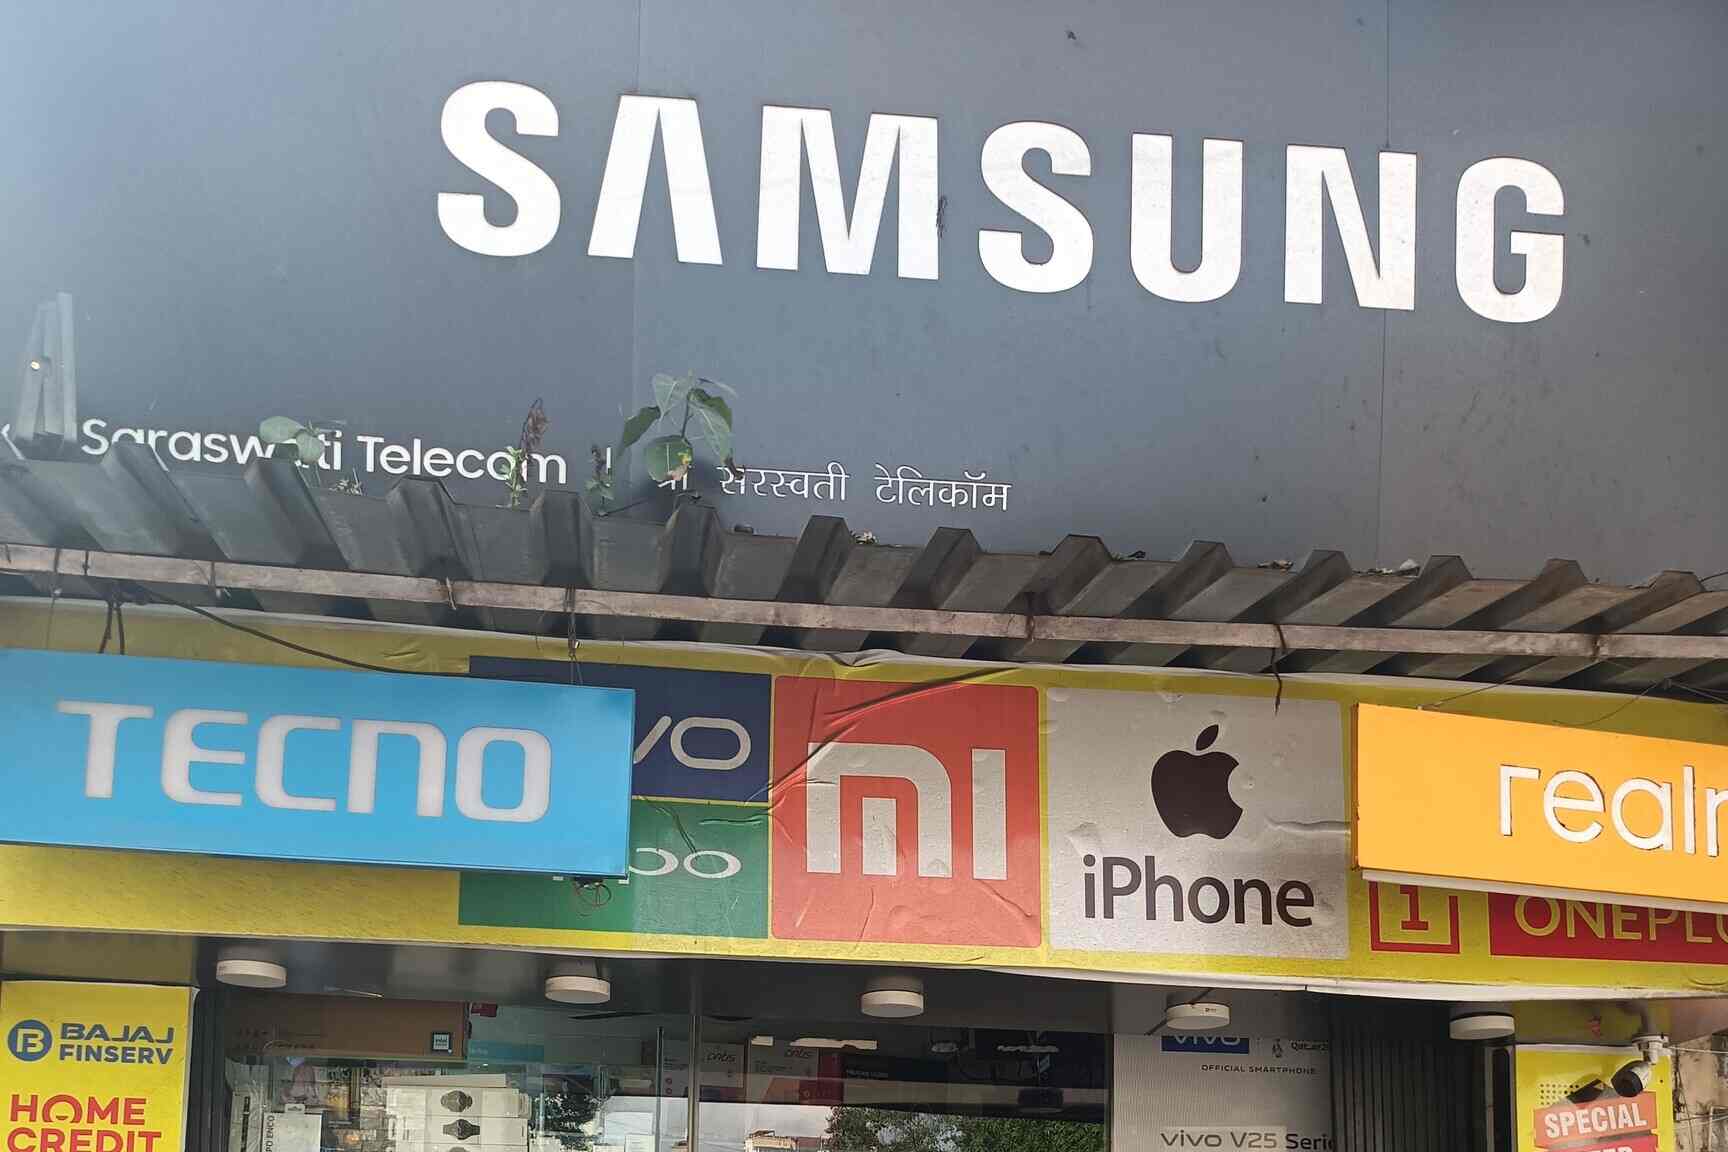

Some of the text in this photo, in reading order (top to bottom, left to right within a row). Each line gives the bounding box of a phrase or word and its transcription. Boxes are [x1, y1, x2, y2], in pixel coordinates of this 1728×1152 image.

[437, 79, 1566, 324] SAMSUNG
[356, 434, 567, 485] Telecom
[874, 462, 1012, 511] टेलिकॉम
[56, 699, 552, 824] TECNO
[1500, 763, 1728, 858] real
[1083, 852, 1315, 928] iPhone
[1514, 894, 1728, 945] ONEPL
[59, 1043, 174, 1065] FINSERV
[60, 1022, 175, 1044] BAJAJ
[9, 1093, 148, 1125] HOME
[266, 1114, 276, 1139] ENCO
[1543, 1101, 1648, 1139] SPECIAL
[1160, 1129, 1334, 1151] vivo V25 Seri
